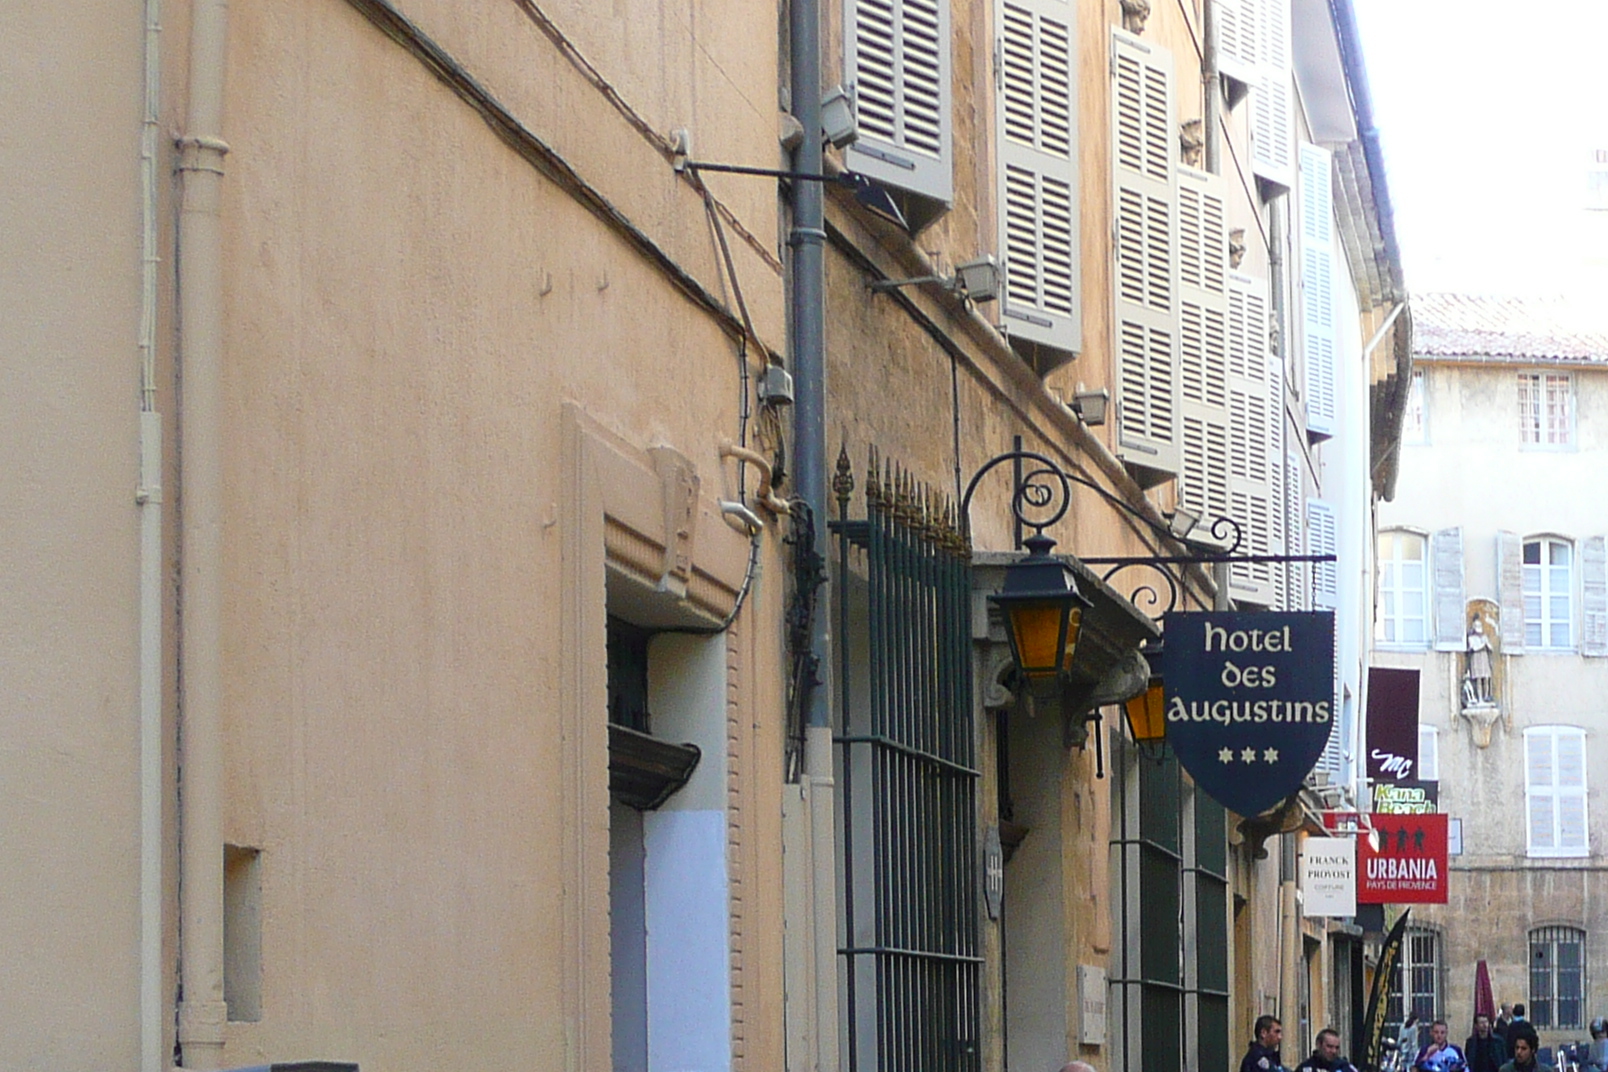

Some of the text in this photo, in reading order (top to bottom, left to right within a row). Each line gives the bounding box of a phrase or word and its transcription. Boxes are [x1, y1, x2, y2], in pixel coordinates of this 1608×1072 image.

[1221, 660, 1276, 688] des
[1374, 783, 1426, 802] Kana
[1309, 855, 1349, 866] FRANCK
[1308, 869, 1350, 879] PROVOST
[1367, 858, 1438, 880] URBANIA
[1366, 881, 1437, 891] PAYS DE PROVENCE
